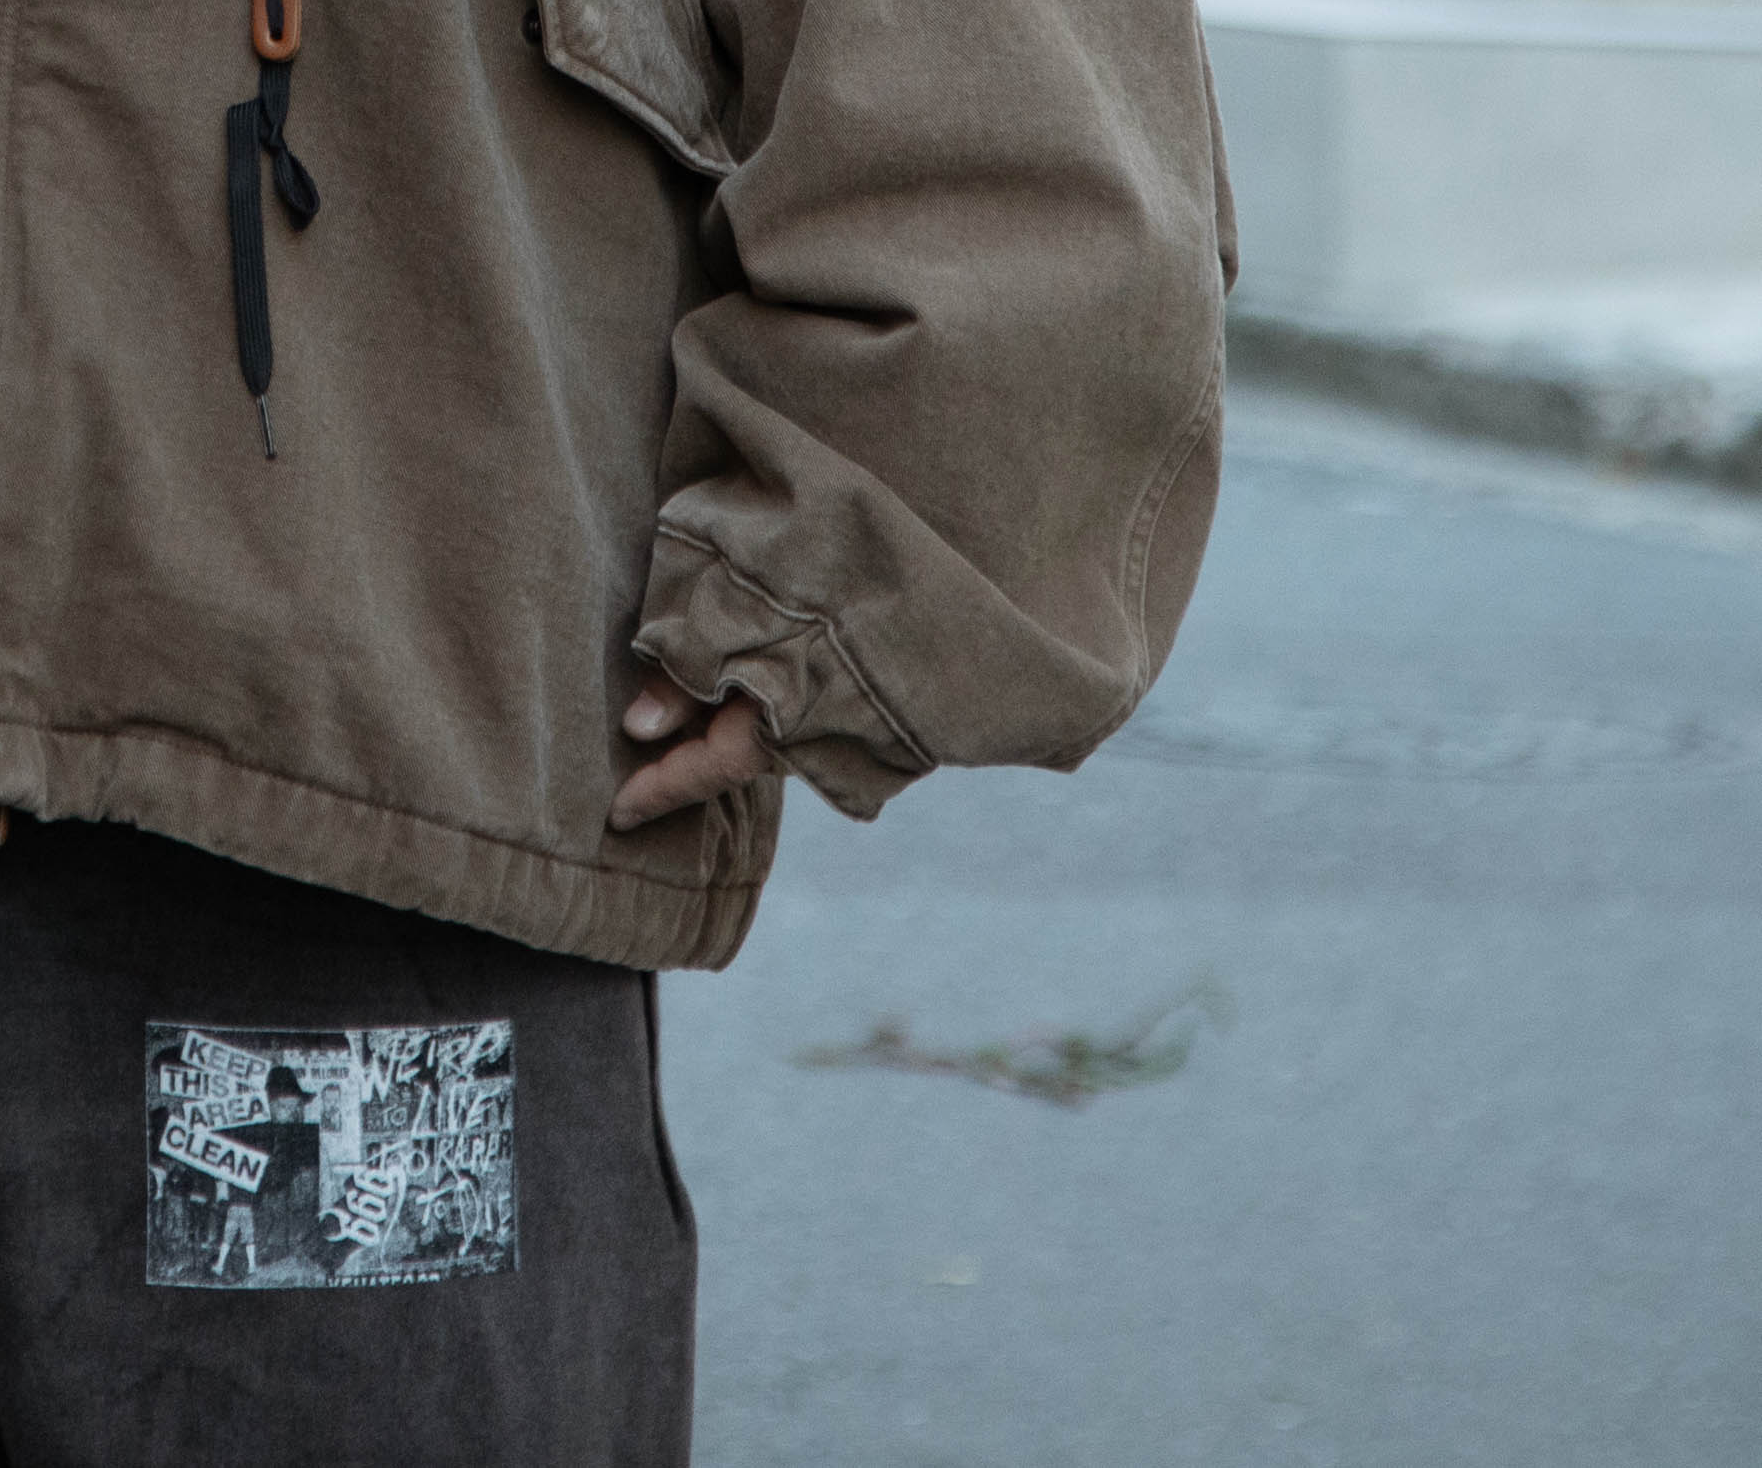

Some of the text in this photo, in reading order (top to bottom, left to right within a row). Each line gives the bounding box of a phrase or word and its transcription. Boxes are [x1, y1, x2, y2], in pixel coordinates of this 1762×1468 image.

[189, 1037, 266, 1079] KEEP
[163, 1067, 229, 1098] THIS
[189, 1098, 263, 1129] AREA
[165, 1125, 261, 1182] CLEAN
